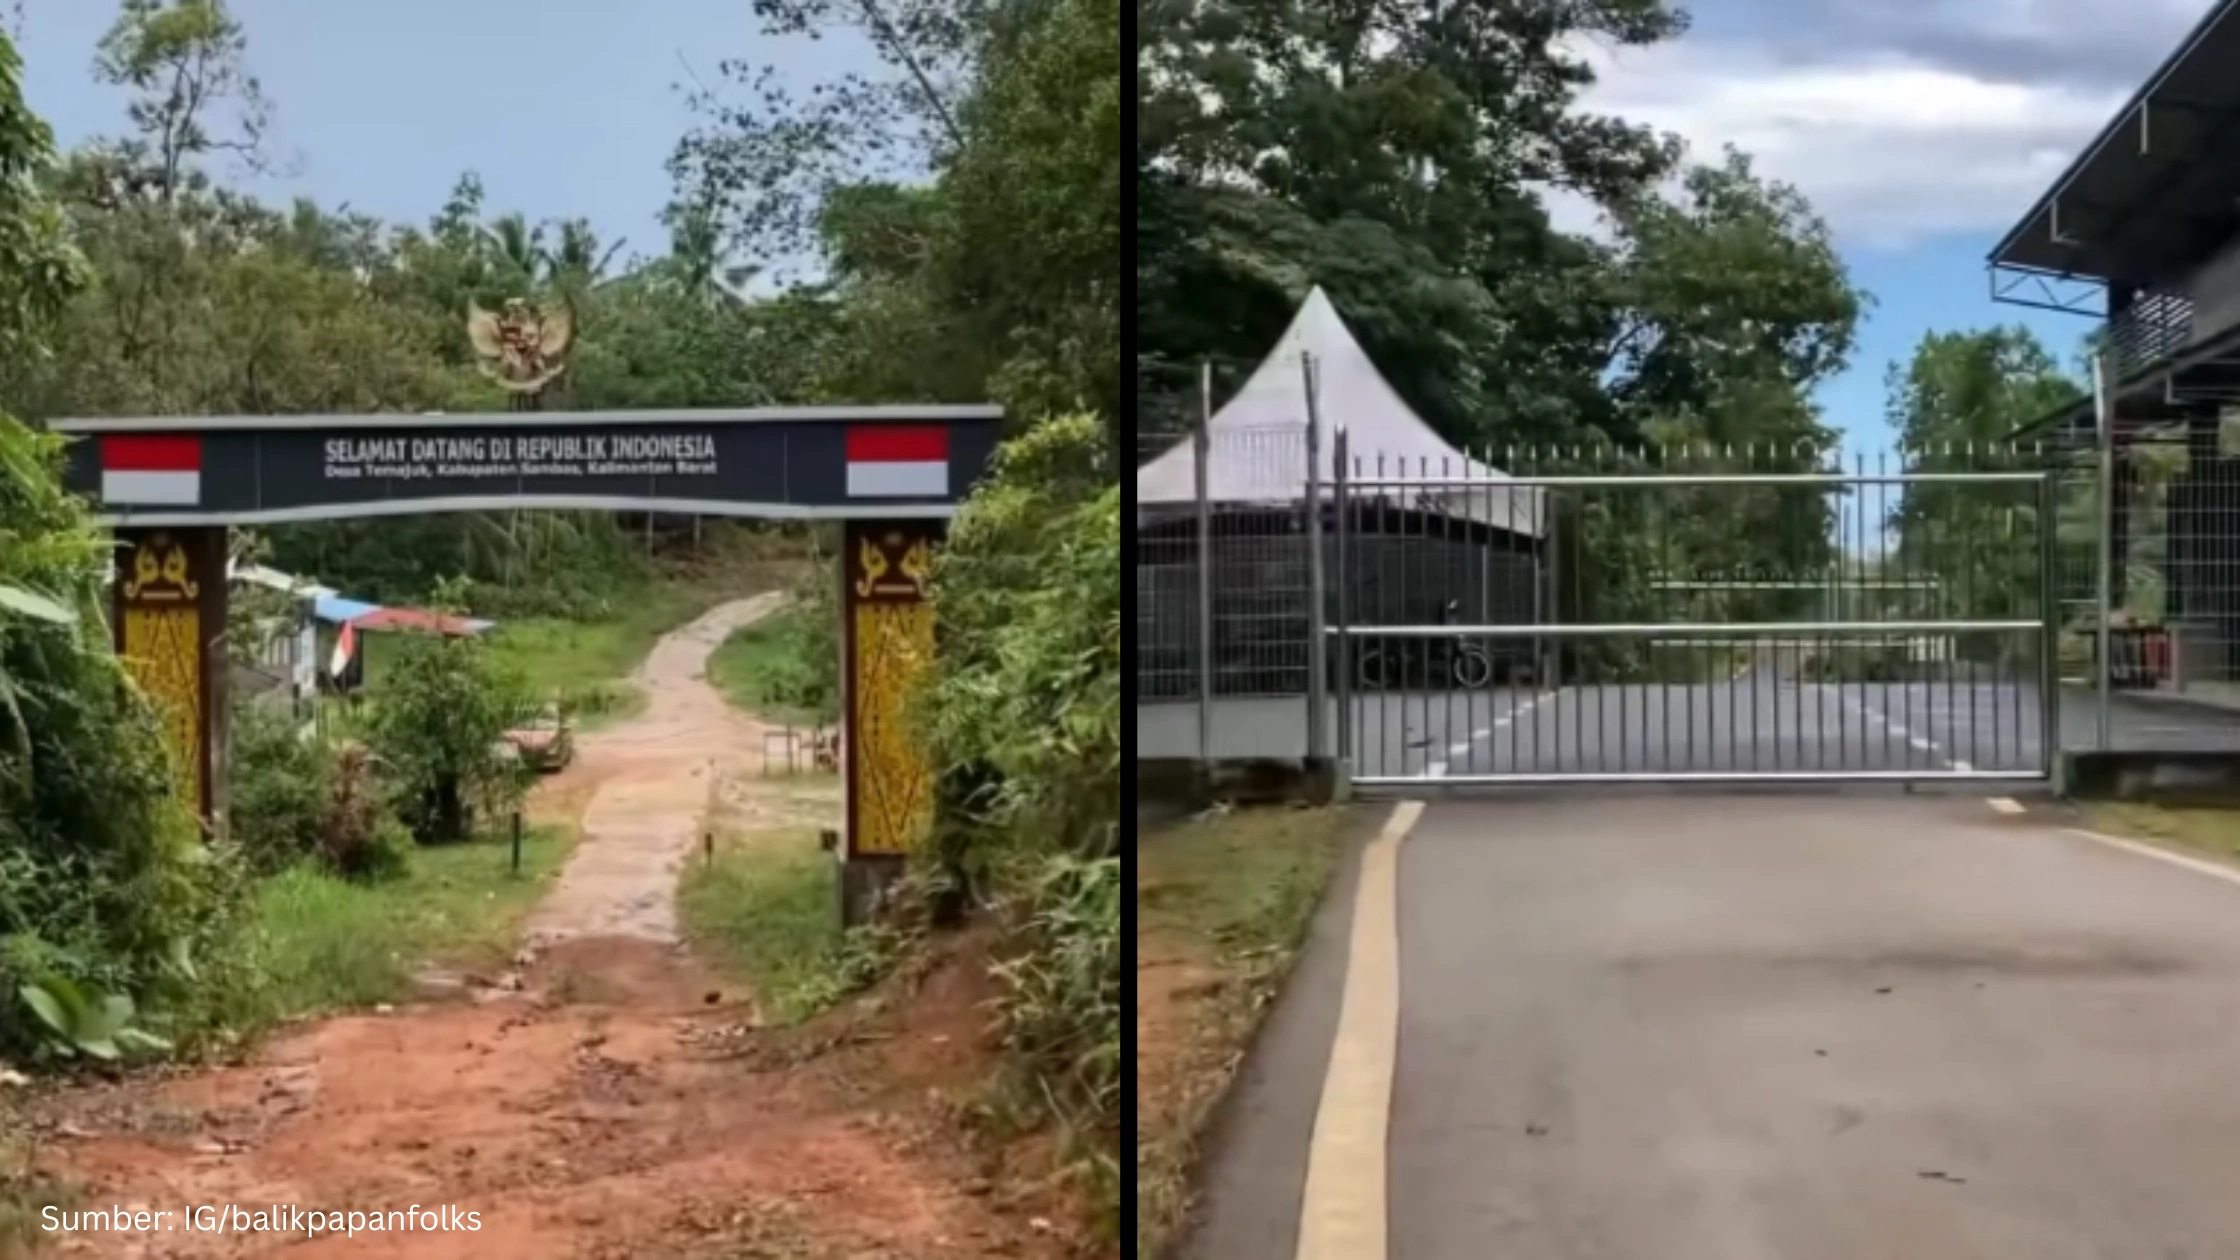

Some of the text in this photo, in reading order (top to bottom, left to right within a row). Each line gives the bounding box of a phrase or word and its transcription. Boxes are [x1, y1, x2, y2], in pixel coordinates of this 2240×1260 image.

[325, 434, 716, 463] SELAMAT DATANG DI REPUBLIK INDONESIA
[324, 464, 361, 478] Desa
[437, 464, 516, 477] Kabupaten
[587, 462, 672, 475] Kalimantan
[676, 460, 717, 474] Barat
